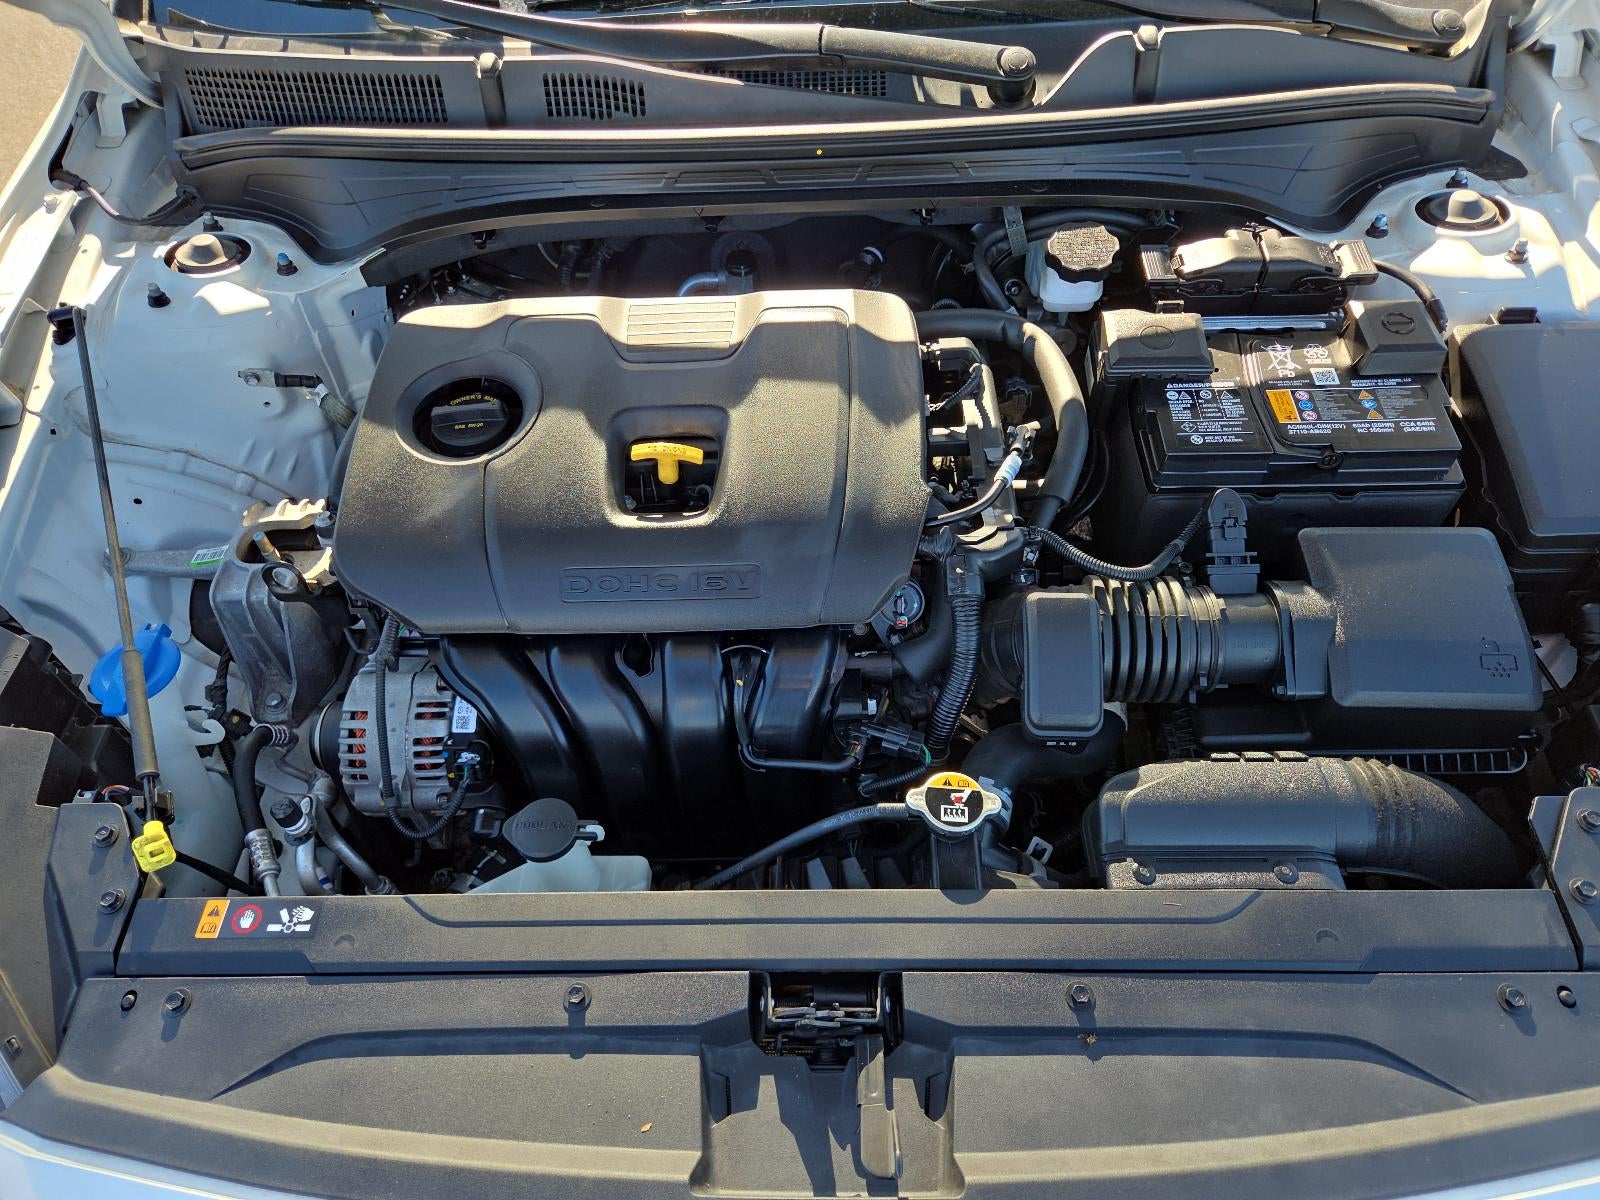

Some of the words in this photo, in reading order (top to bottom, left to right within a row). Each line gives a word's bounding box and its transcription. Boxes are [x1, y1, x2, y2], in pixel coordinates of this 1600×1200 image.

[1277, 369, 1296, 378] Pb
[450, 394, 482, 406] OWNER'S
[565, 574, 679, 594] DOHC
[690, 571, 758, 592] 16V
